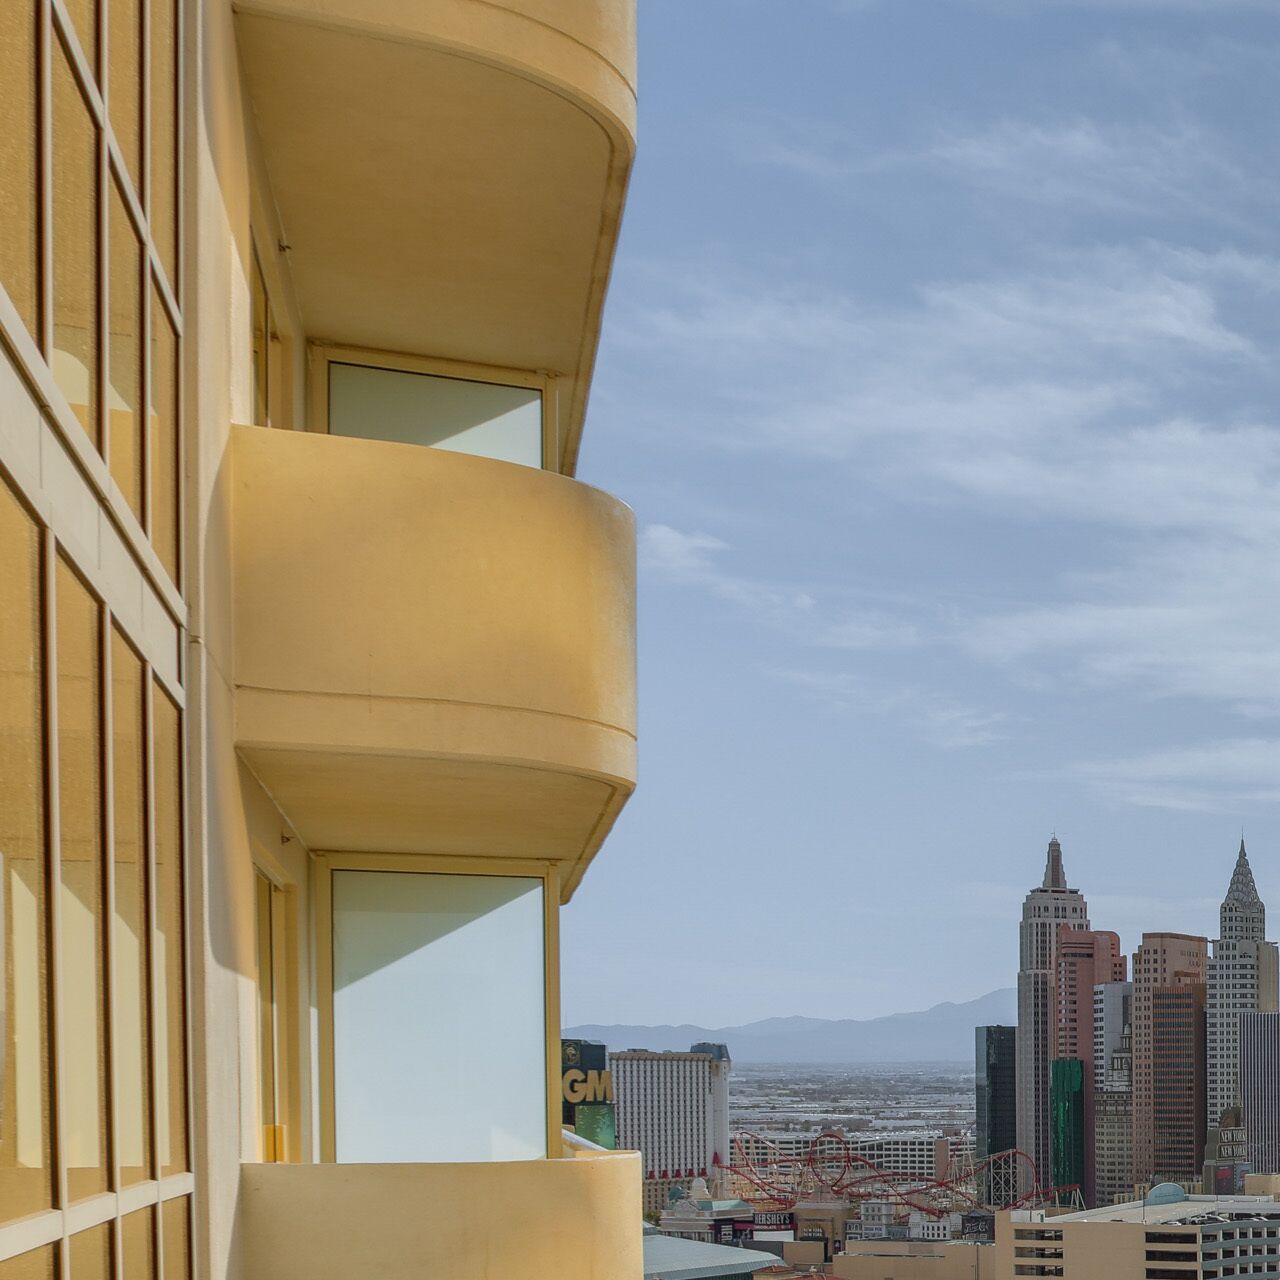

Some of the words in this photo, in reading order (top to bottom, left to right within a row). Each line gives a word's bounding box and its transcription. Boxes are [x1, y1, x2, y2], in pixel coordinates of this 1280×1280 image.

[562, 1068, 614, 1104] GM
[1220, 1130, 1232, 1142] NEW
[1233, 1129, 1246, 1142] YORK
[1220, 1145, 1232, 1157] NEW
[1233, 1145, 1246, 1157] YORK
[754, 1213, 790, 1225] HERSHEY'S
